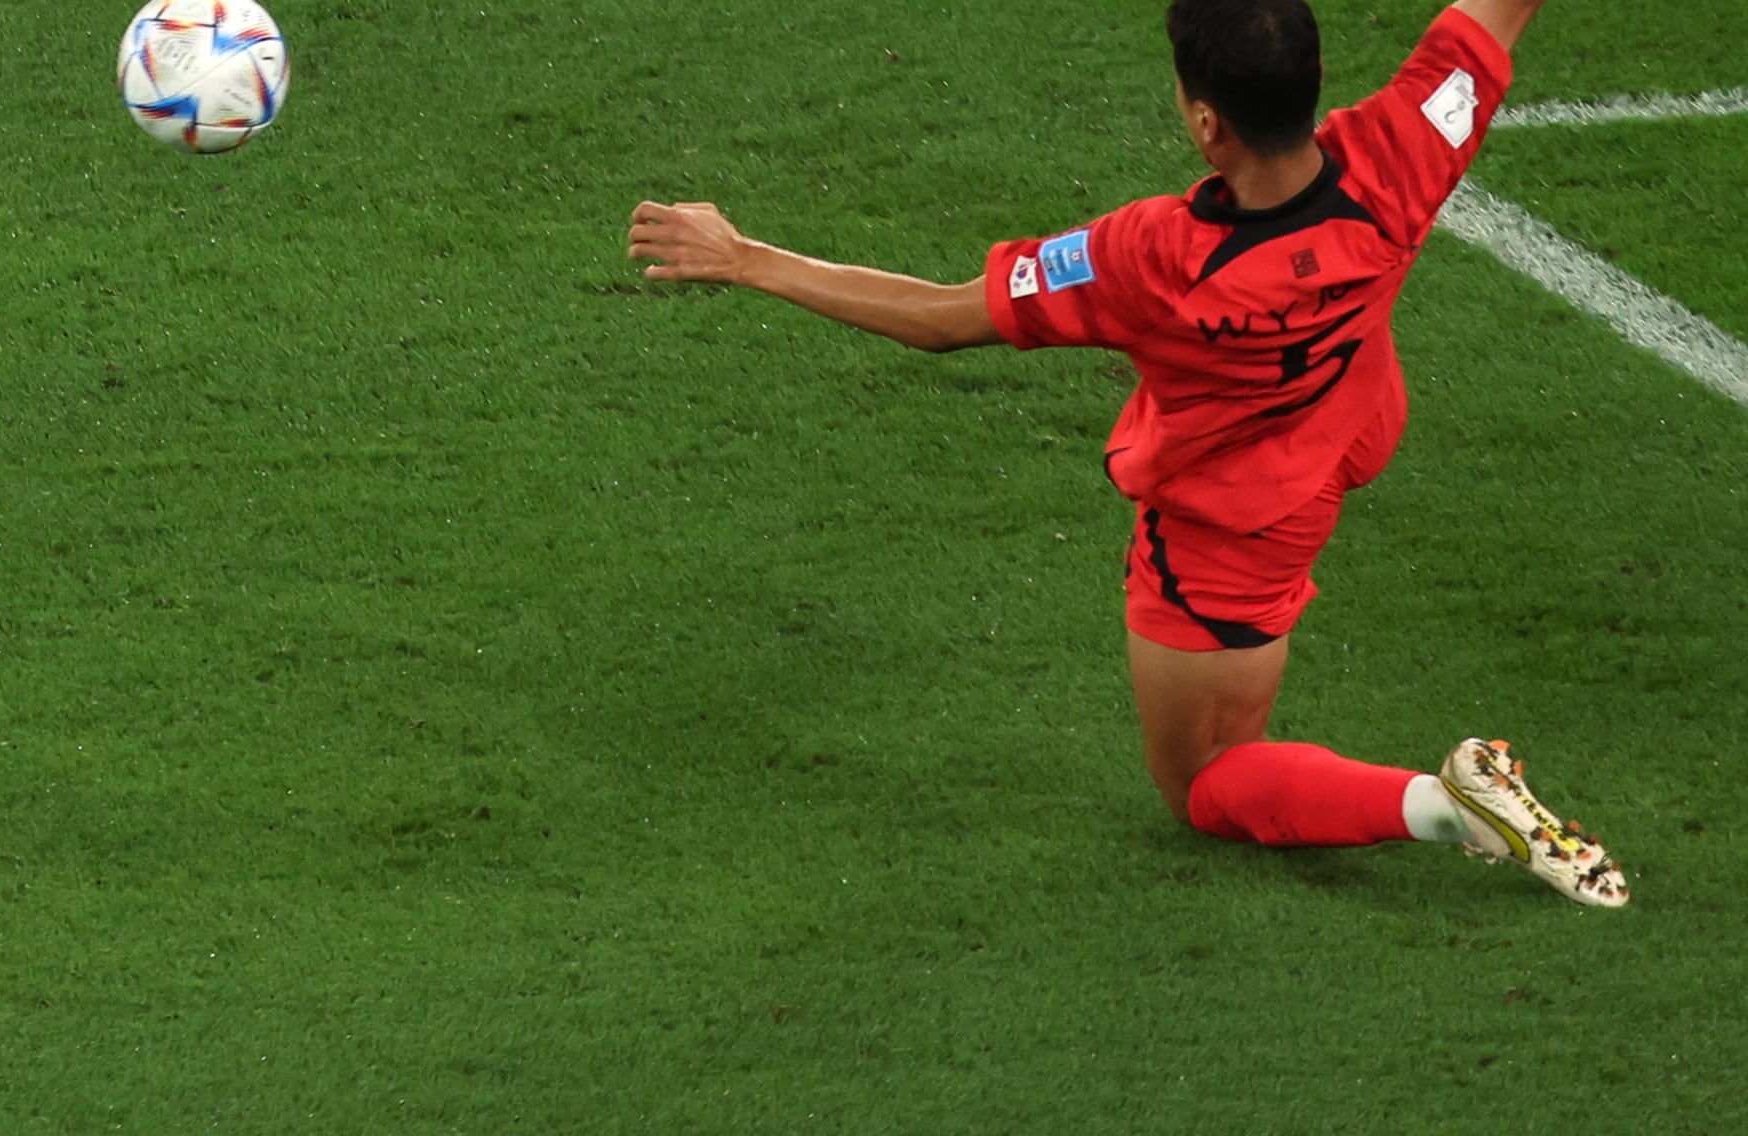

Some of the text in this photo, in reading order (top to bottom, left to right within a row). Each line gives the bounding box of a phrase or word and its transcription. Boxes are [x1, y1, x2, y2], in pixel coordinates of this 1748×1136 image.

[1197, 312, 1250, 343] W
[1268, 300, 1299, 333] Y
[1259, 304, 1366, 419] 5
